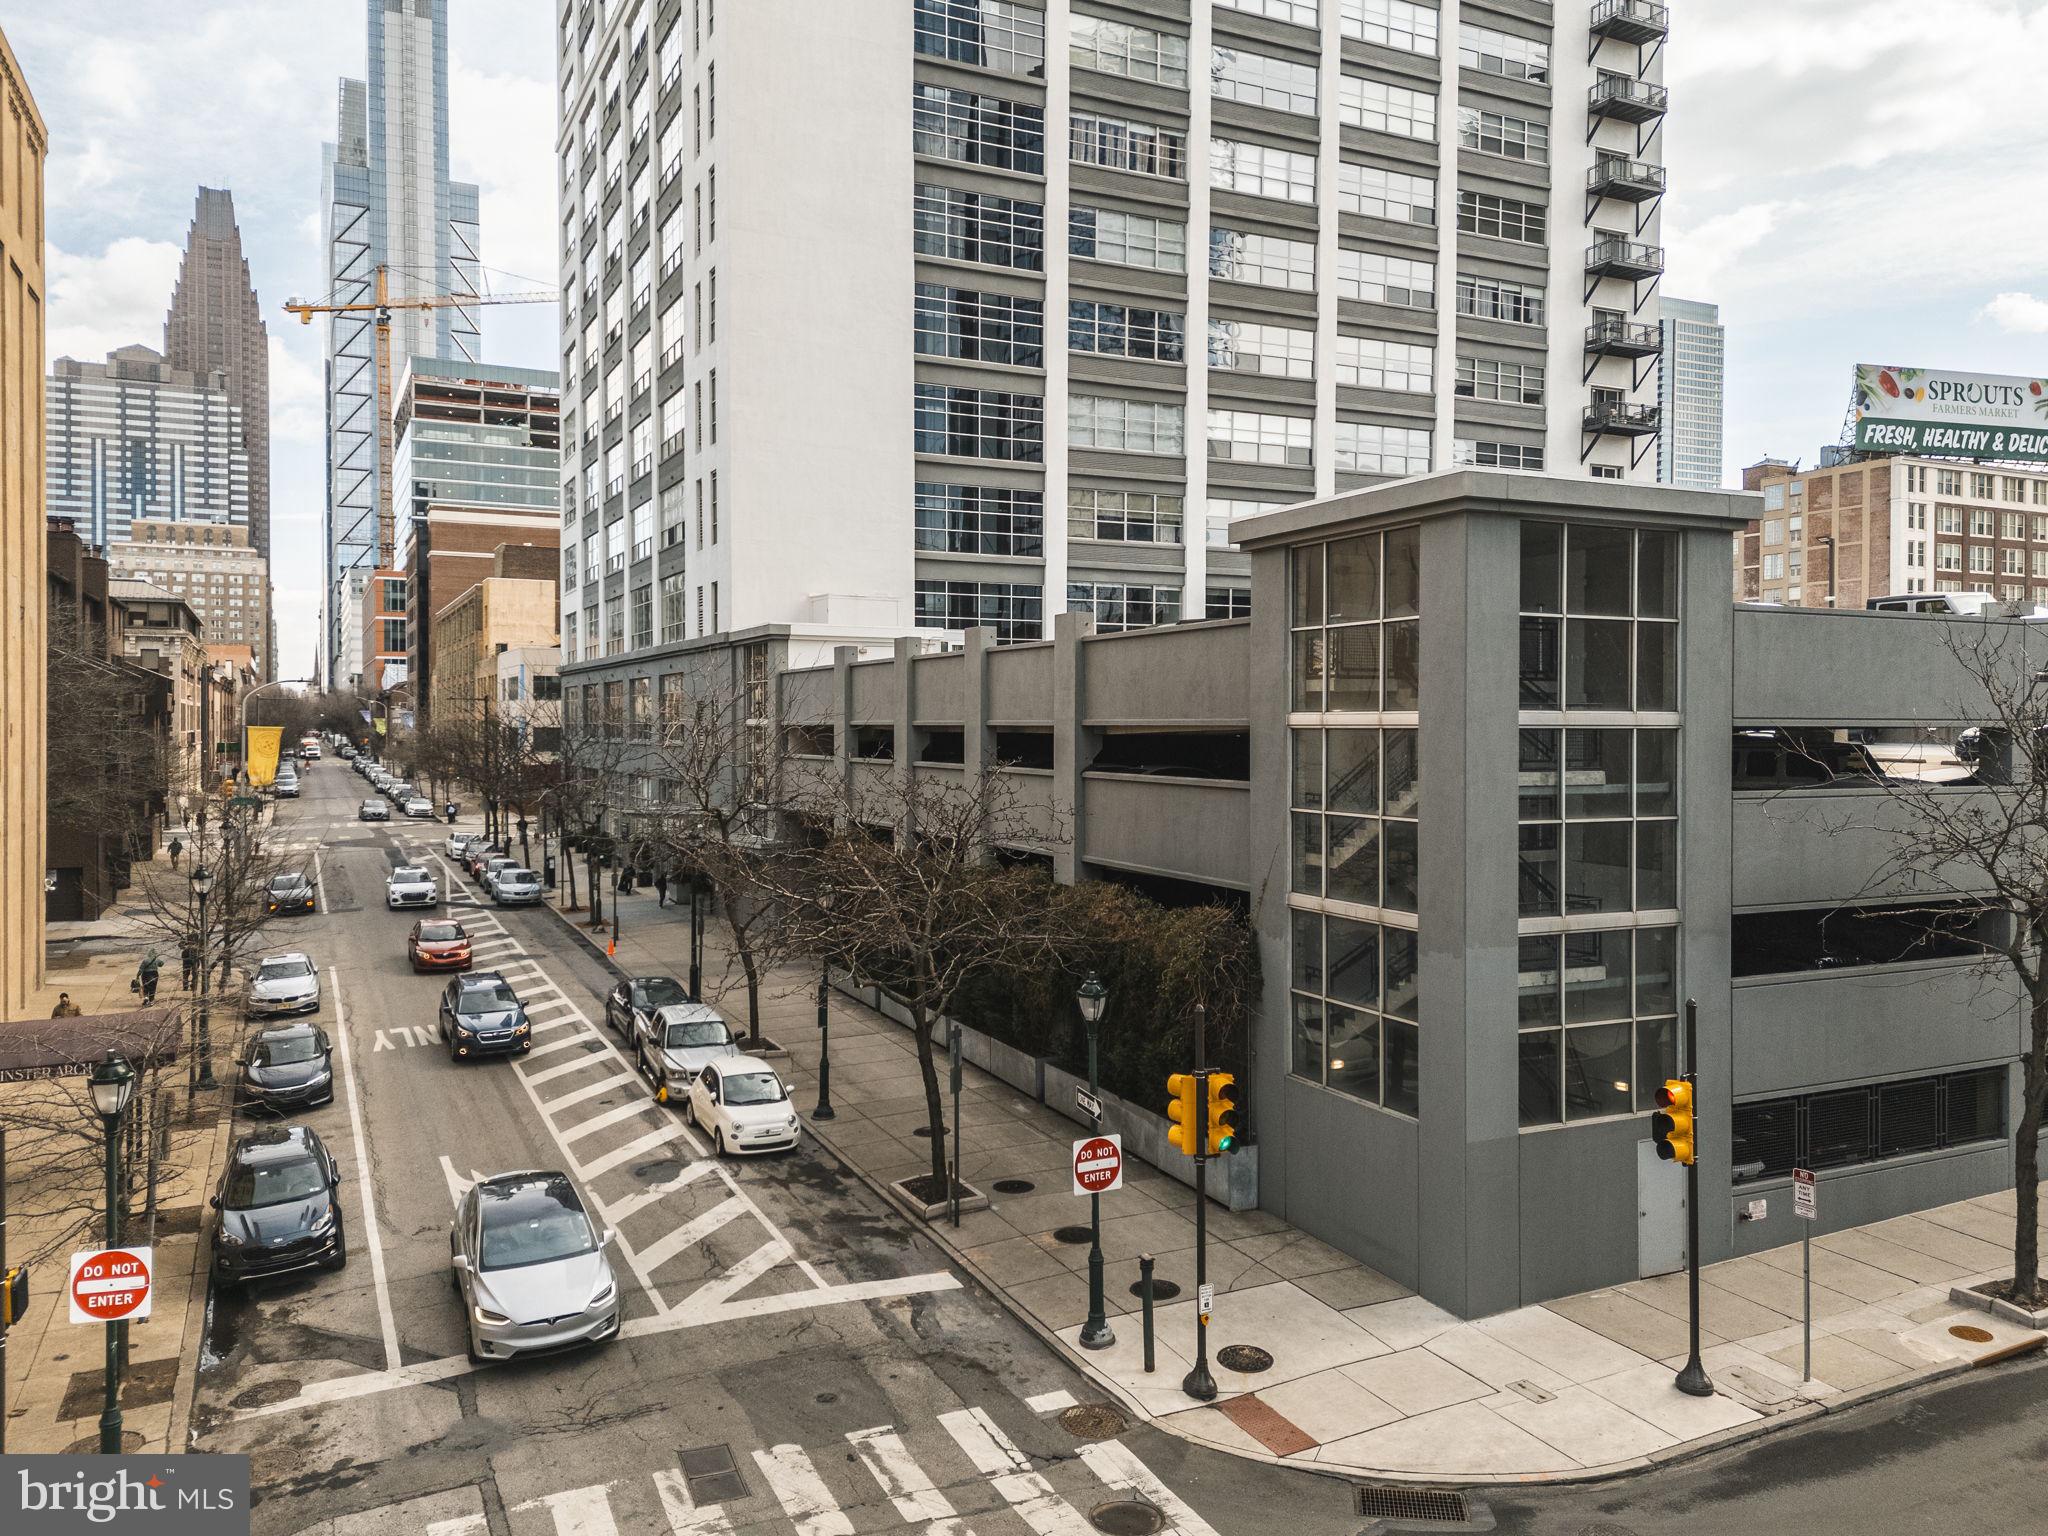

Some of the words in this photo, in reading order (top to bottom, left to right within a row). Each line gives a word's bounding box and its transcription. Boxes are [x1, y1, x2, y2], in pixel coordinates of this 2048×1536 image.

[1928, 381, 2024, 406] SPROUTS
[1932, 403, 1977, 416] FARMERS
[1978, 407, 2020, 419] MARKET
[1864, 424, 1918, 449] FRESH,
[1923, 428, 1990, 451] HEALTHY
[1992, 432, 2004, 451] &
[373, 1024, 442, 1053] NLY
[1080, 1151, 1093, 1161] DO
[1097, 1146, 1114, 1157] NOT
[1084, 1170, 1111, 1183] ENTER
[1799, 1170, 1809, 1180] NO
[83, 1265, 104, 1278] DO
[111, 1262, 139, 1276] NOT
[88, 1293, 133, 1308] ENTER
